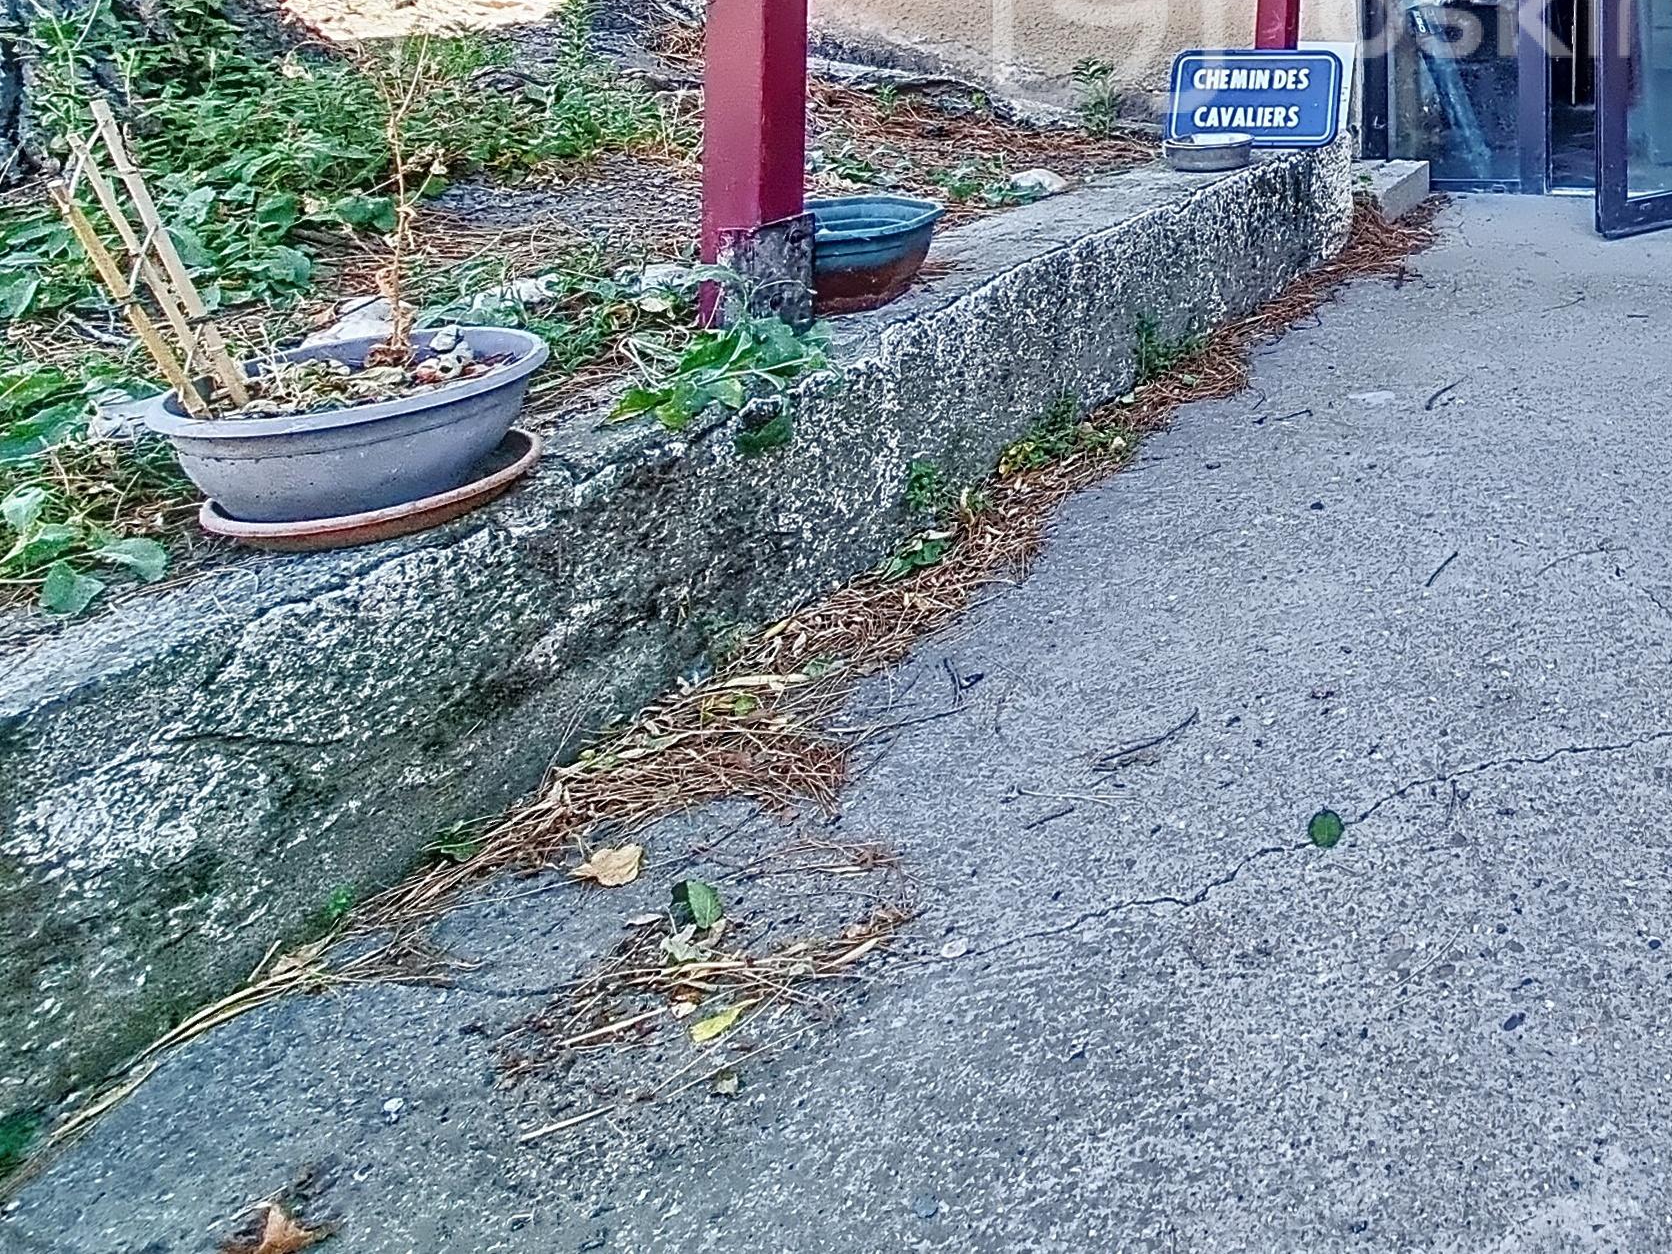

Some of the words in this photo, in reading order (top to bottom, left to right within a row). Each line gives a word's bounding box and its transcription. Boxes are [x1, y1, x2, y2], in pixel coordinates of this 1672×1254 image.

[1193, 68, 1270, 90] CHEMIN
[1273, 68, 1310, 90] DES
[1193, 106, 1300, 128] CAVALIERS
